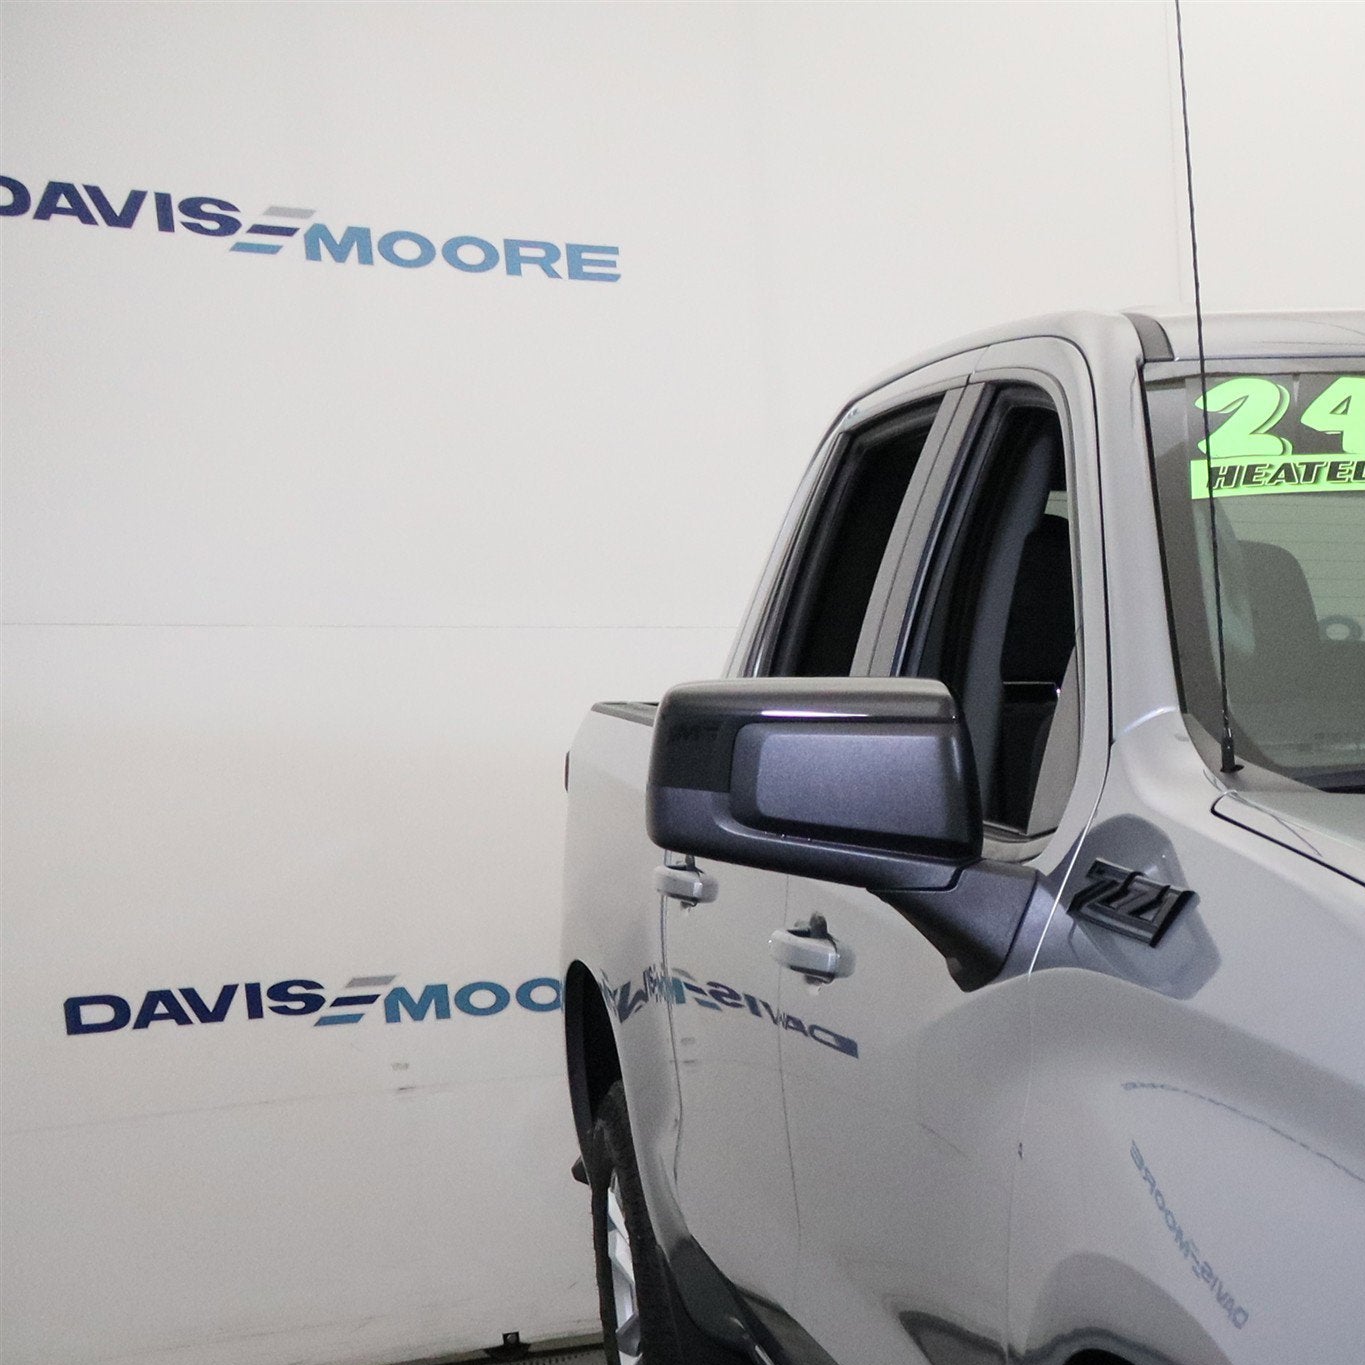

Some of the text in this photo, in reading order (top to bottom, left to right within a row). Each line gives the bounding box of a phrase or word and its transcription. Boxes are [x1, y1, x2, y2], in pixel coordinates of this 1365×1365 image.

[303, 222, 621, 283] MOORE
[1066, 857, 1198, 949] Z71
[63, 979, 326, 1036] DAVIS
[384, 976, 563, 1024] MOO
